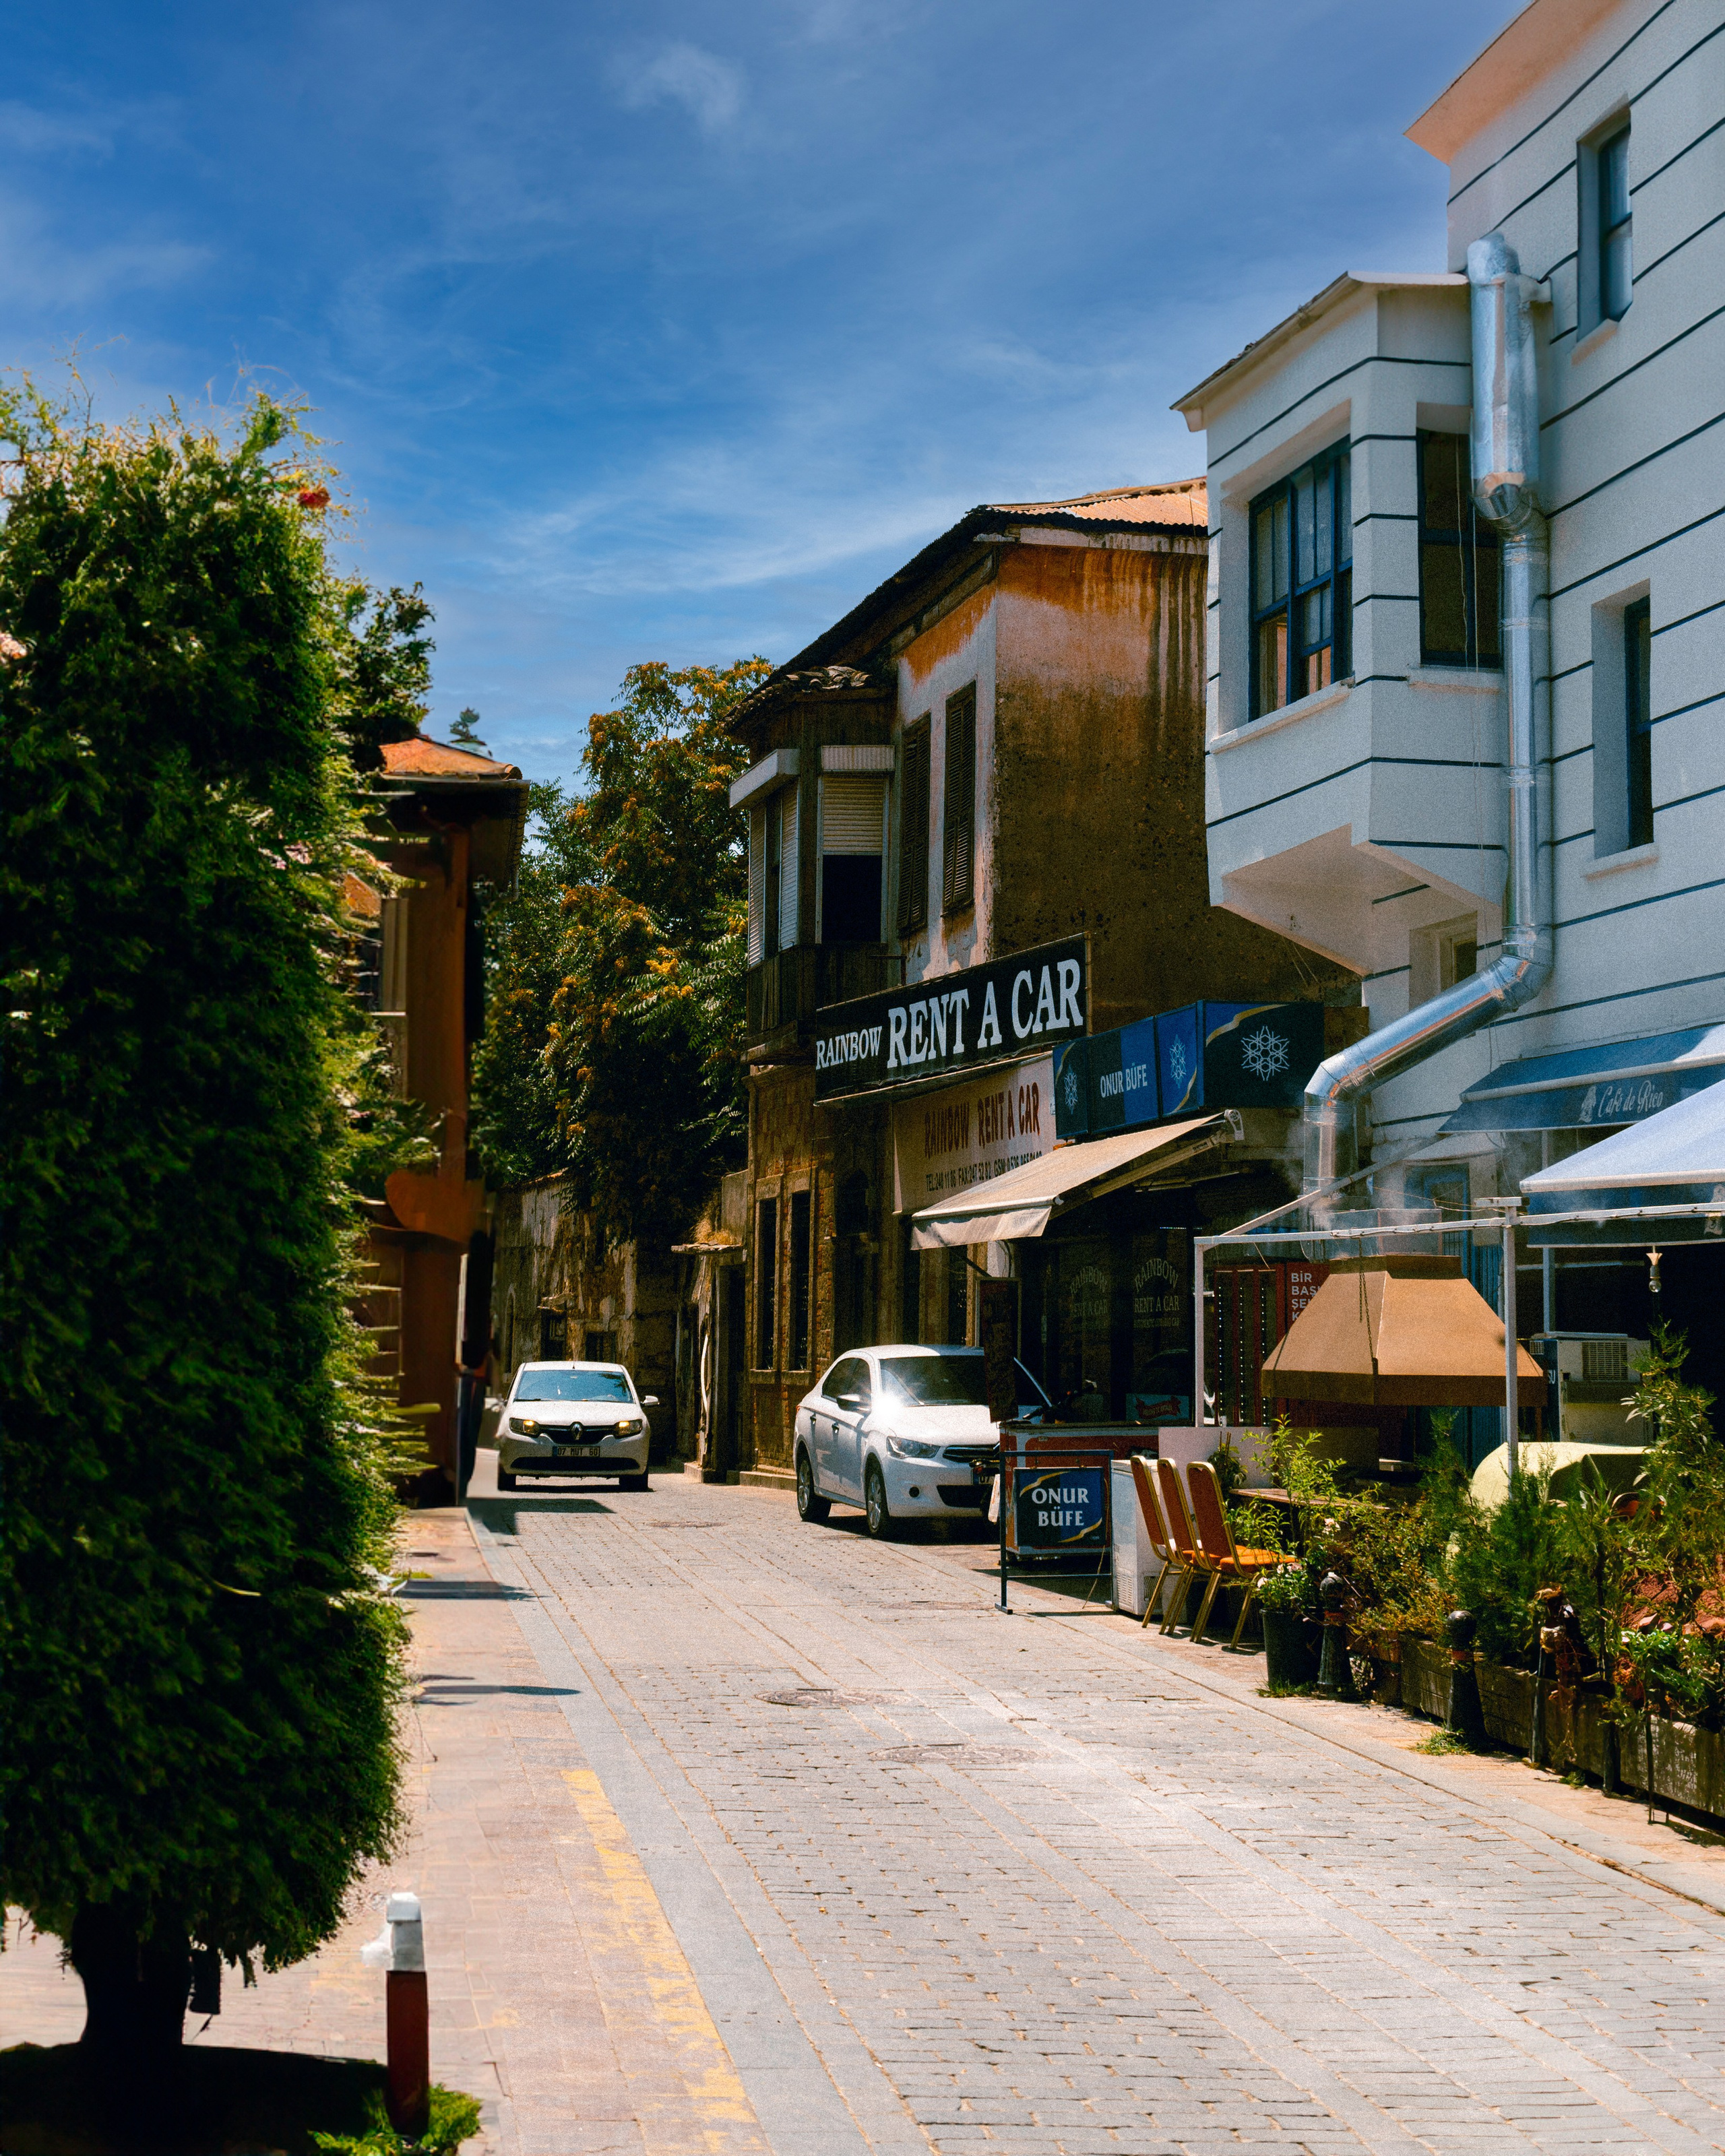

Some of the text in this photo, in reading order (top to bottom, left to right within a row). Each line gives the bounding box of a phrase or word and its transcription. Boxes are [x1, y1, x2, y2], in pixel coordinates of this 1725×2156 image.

[815, 958, 1084, 1070] RAINBOW RENT A CAR
[1100, 1063, 1148, 1098] ONUR BÜFE
[1623, 1087, 1635, 1112] de
[1637, 1080, 1664, 1114] Rico
[924, 1082, 1040, 1159] RAINBOW RENT A CAR
[1134, 1257, 1178, 1294] RAINBOW
[1291, 1270, 1312, 1283] BİR
[1135, 1295, 1179, 1313] RENT A CAR
[1292, 1298, 1311, 1310] ŞE
[1031, 1488, 1090, 1504] ONUR
[1038, 1506, 1084, 1527] BÜFE
